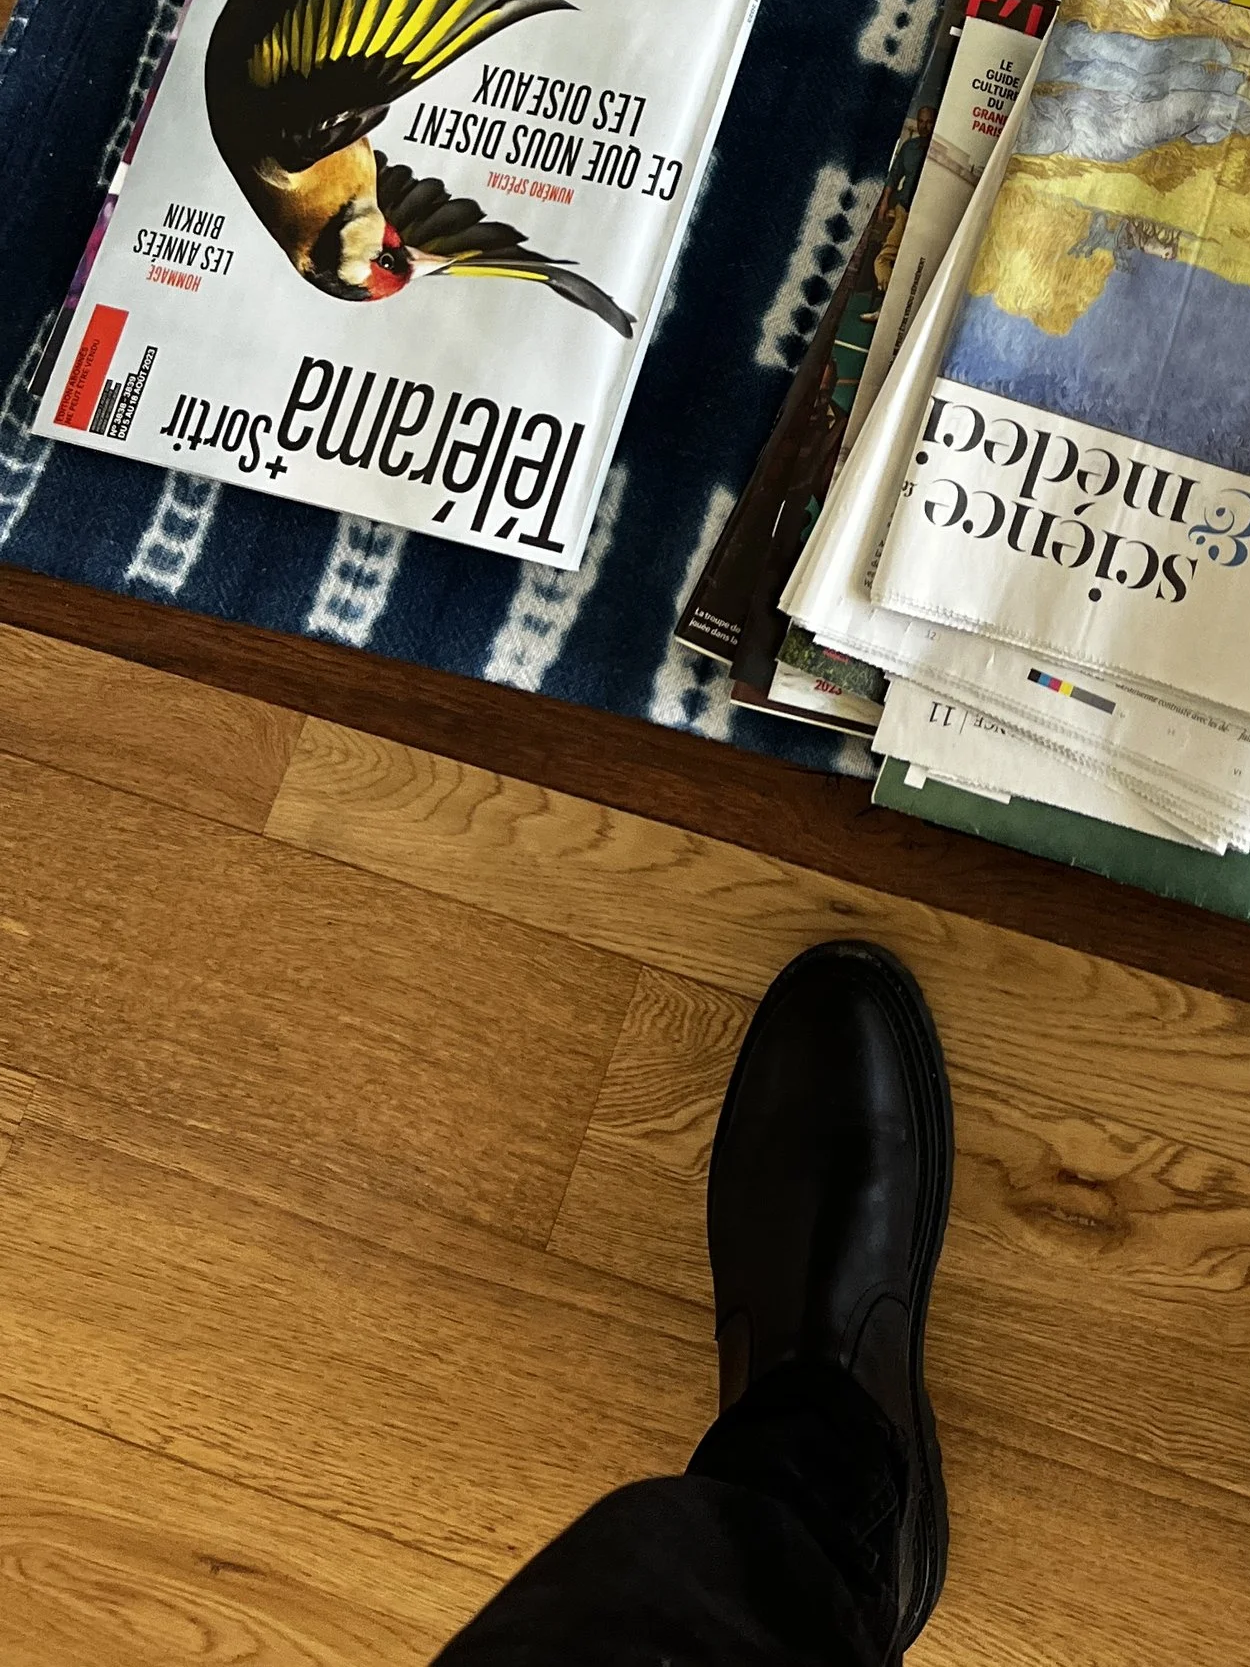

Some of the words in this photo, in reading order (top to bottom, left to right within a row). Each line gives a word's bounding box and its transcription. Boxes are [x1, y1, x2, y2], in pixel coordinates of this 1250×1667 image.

[986, 69, 1020, 88] GUIDE
[1000, 59, 1013, 72] LE
[472, 64, 592, 125] OISEAUX
[987, 97, 1004, 110] DU
[592, 90, 647, 137] LES
[403, 102, 506, 160] DISENT
[505, 124, 585, 177] NOUS
[582, 141, 642, 190] QUE
[486, 171, 529, 195] SPÉCIAL
[642, 154, 683, 201] CE
[530, 185, 574, 205] NUMÉRO
[163, 203, 225, 240] BIRKIN
[133, 229, 201, 267] ANNÉES
[200, 245, 234, 275] LES
[146, 264, 203, 292] HOMMAGE
[142, 347, 155, 370] 2023
[276, 355, 585, 553] Télérama
[924, 478, 1198, 603] science
[689, 618, 710, 634] jouée
[711, 628, 730, 641] dans
[704, 612, 730, 630] troupe
